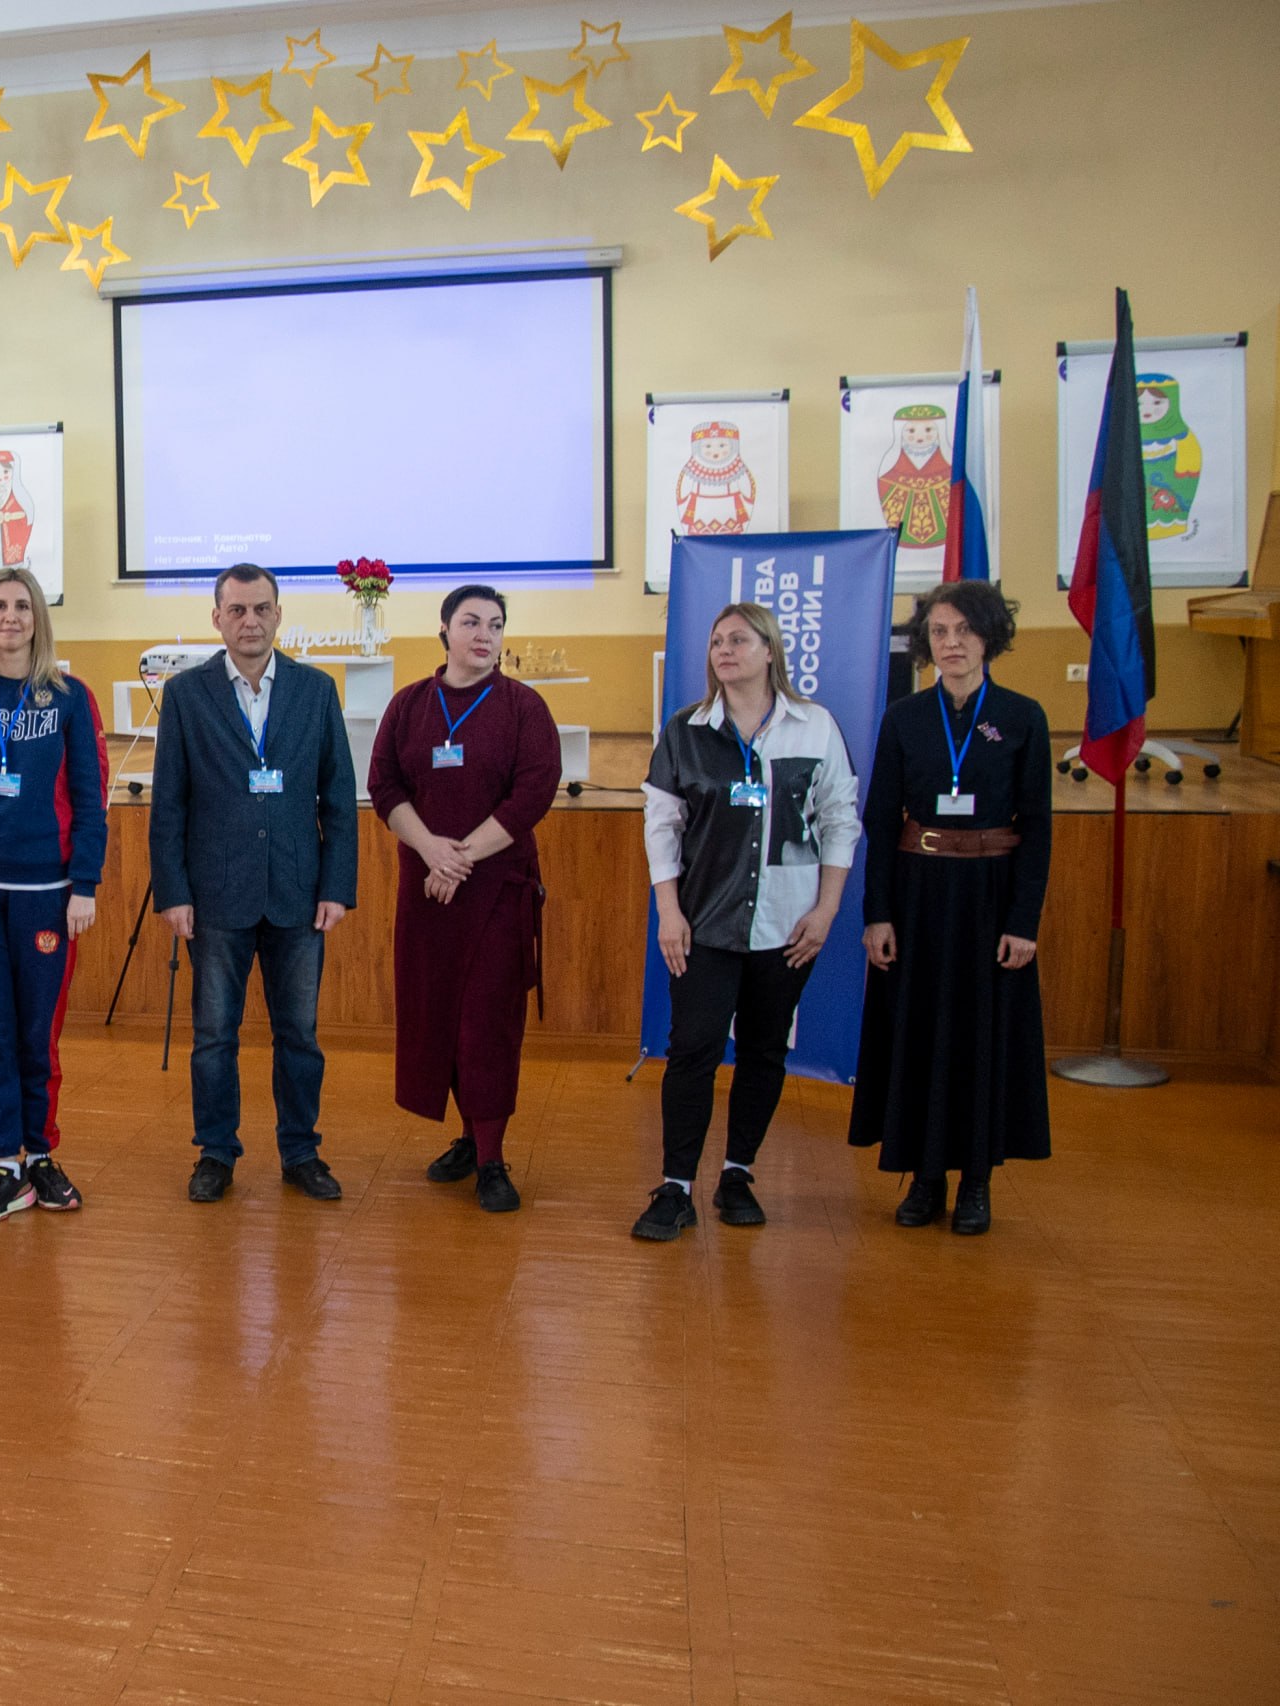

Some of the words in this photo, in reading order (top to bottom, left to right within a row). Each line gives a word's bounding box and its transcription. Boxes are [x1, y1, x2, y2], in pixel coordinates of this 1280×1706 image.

[213, 533, 272, 544] Компьютер
[214, 543, 249, 553] (Авто)
[798, 590, 823, 700] ОССИИ
